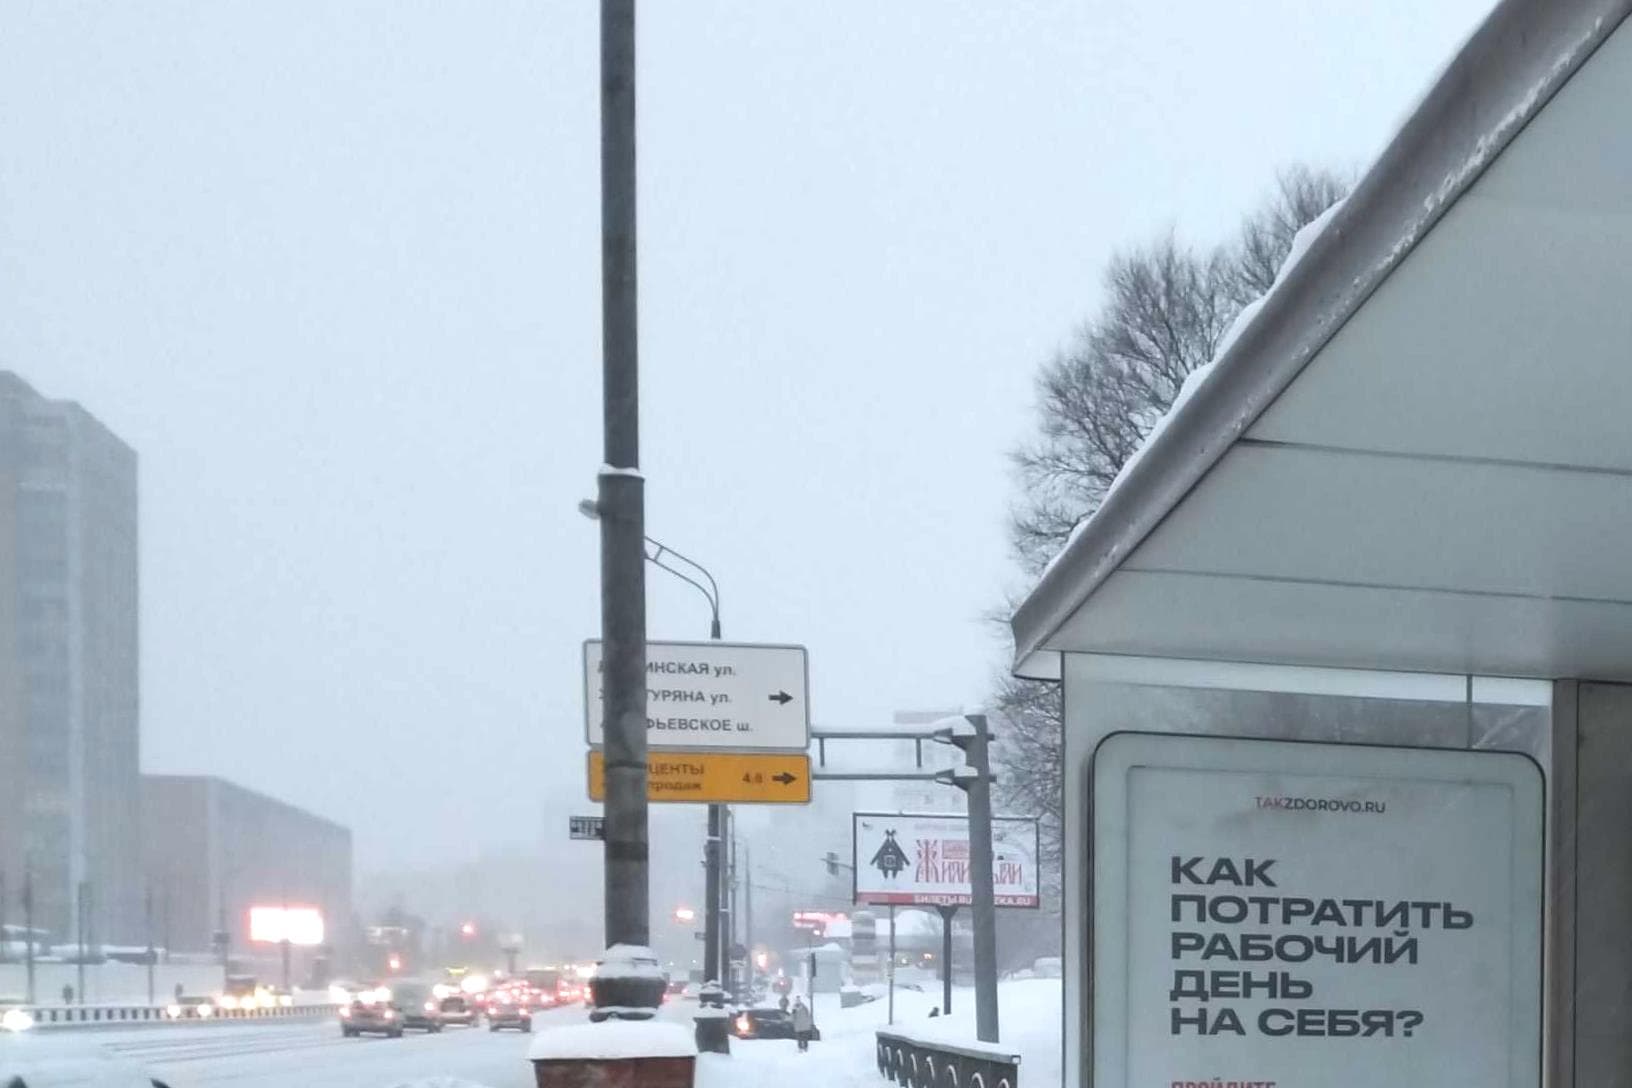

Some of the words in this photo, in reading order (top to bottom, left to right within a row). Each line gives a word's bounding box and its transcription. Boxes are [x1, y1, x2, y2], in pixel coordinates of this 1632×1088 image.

[714, 664, 736, 677] ул.
[710, 693, 732, 706] ул.
[600, 718, 732, 732] ФЬЕВСКОЕ
[736, 722, 753, 733] ш.
[647, 763, 705, 776] ЦЕНТЫ
[1254, 796, 1386, 814] TAKZDOROVO.RU
[1170, 855, 1277, 888] КАК
[1170, 894, 1474, 930] ПОТРАТИТЬ
[1171, 930, 1418, 965] РАБОЧИЙ
[1169, 970, 1314, 1002] ДЕНЬ
[1170, 1007, 1246, 1036] НА
[1257, 1008, 1424, 1038] СЕБЯ?
